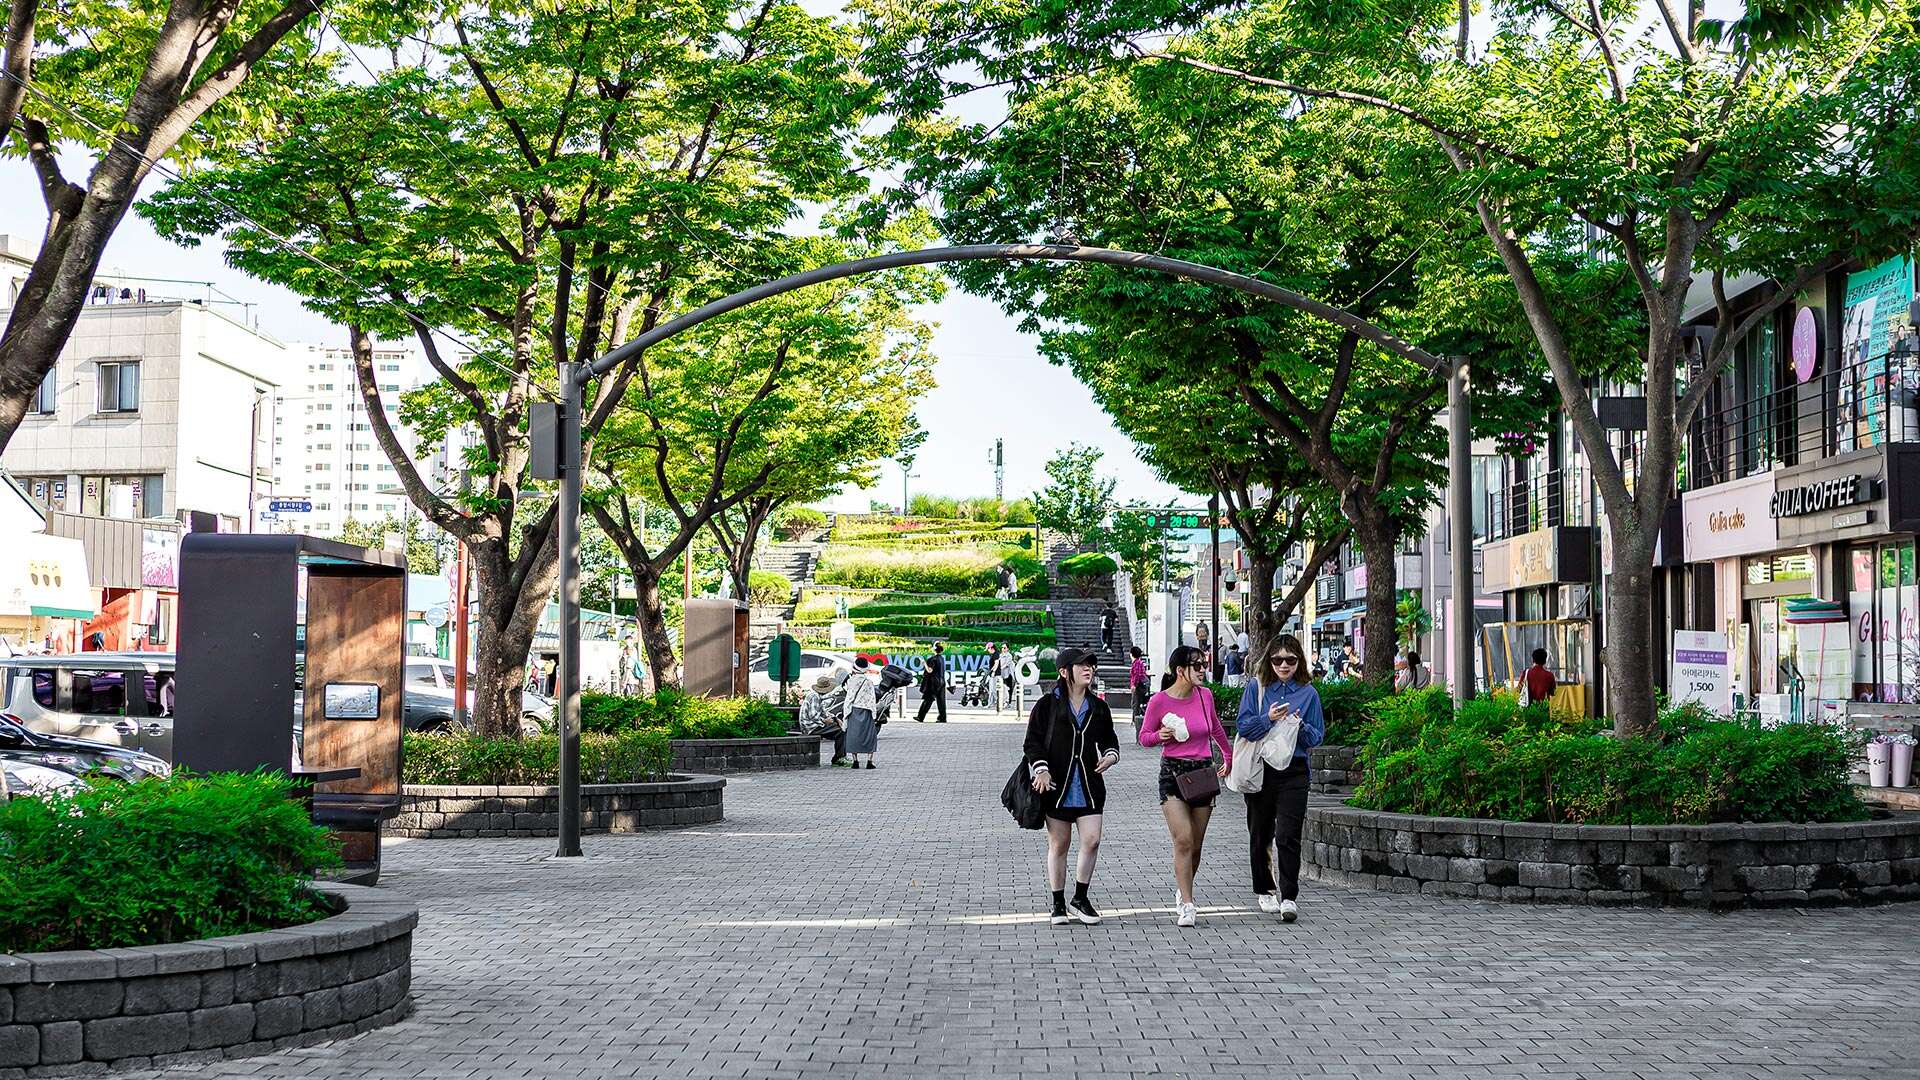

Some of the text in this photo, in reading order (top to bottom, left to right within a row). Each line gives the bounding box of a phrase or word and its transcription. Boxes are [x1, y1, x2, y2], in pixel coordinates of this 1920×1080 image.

[1769, 475, 1856, 518] GULIA COFFEE
[1170, 516, 1199, 528] 20:00
[887, 654, 991, 673] WOHWA
[1681, 668, 1721, 679] 아메리카노
[1689, 682, 1715, 692] 1,500
